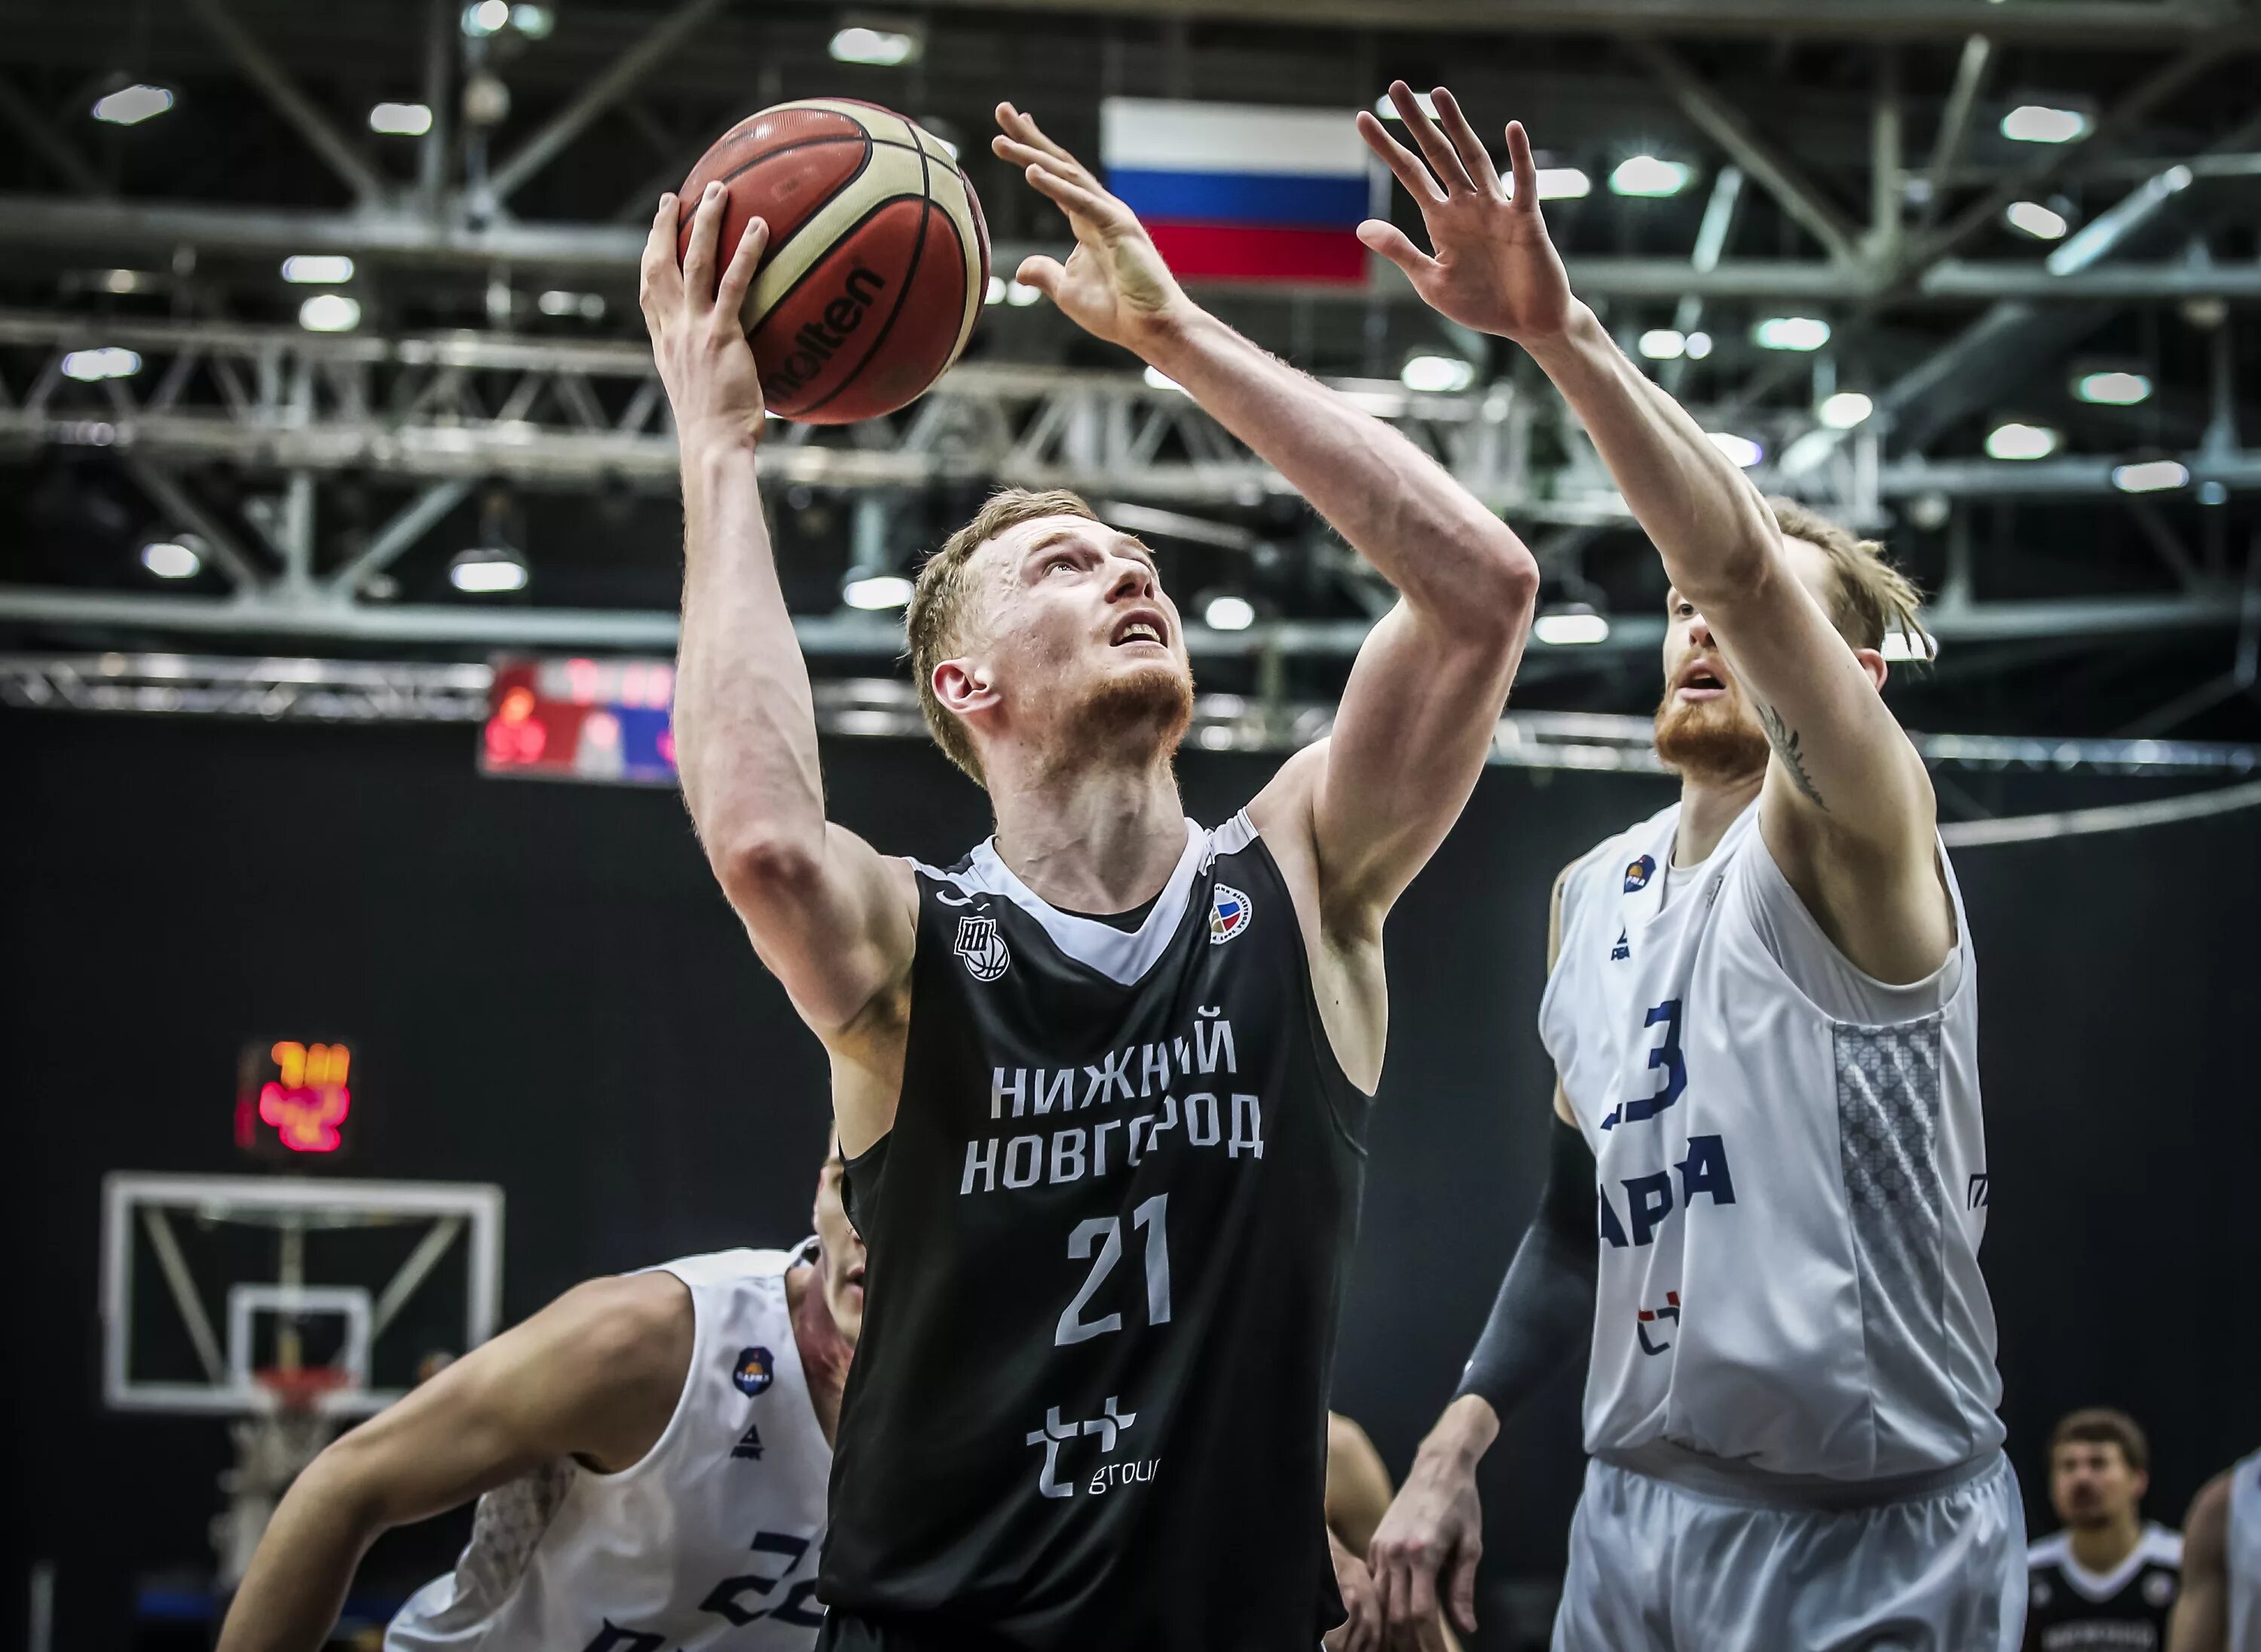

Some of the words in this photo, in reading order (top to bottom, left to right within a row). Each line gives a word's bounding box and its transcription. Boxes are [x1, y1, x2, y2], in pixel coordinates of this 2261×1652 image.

[990, 1005, 1238, 1118] НИЖНИЙ
[1600, 999, 1687, 1130] 3
[959, 1092, 1264, 1195] НОВГОРОД
[1054, 1192, 1171, 1347] 21
[1088, 1458, 1161, 1495] grou
